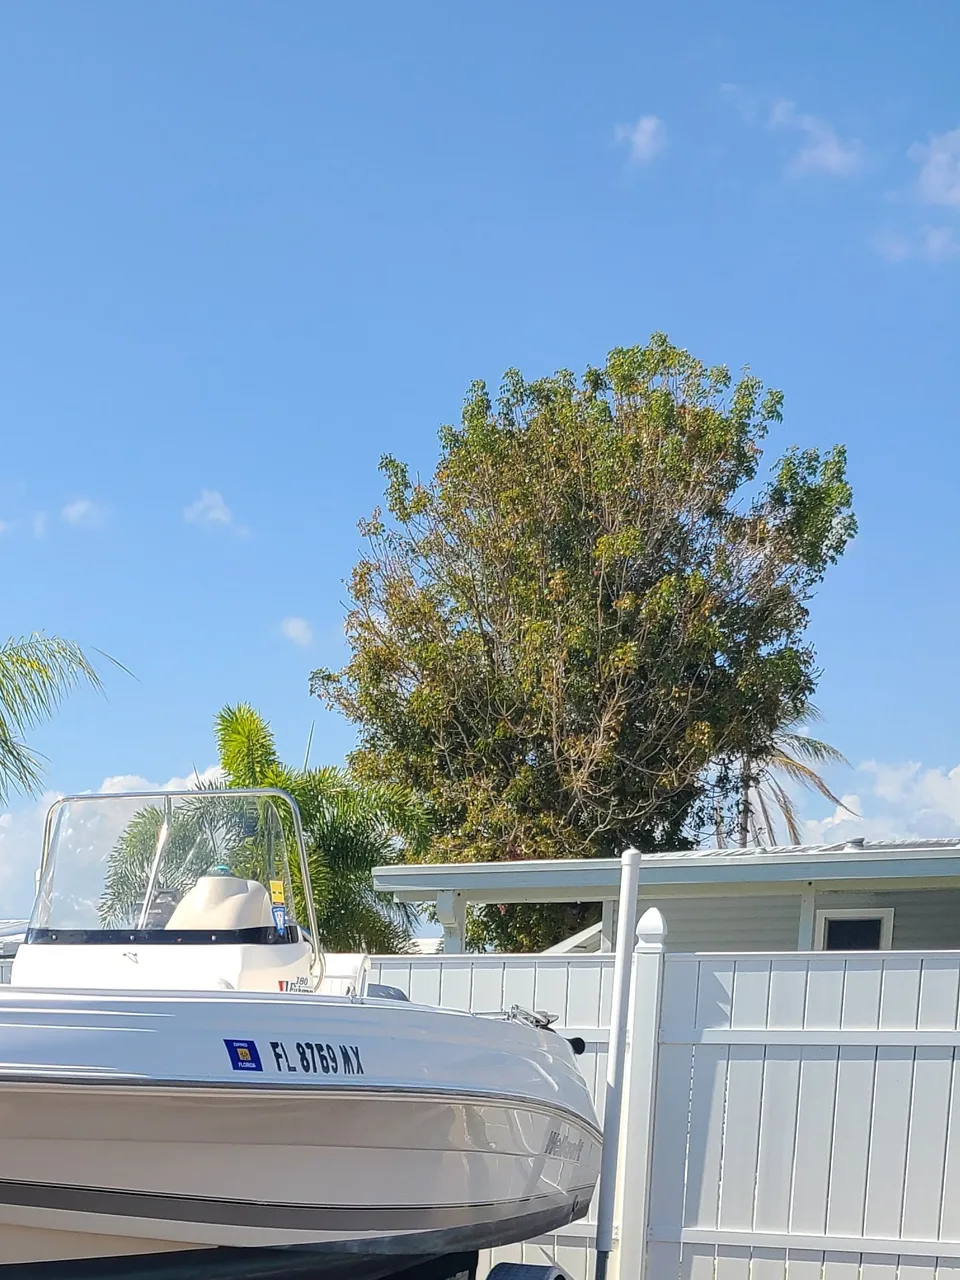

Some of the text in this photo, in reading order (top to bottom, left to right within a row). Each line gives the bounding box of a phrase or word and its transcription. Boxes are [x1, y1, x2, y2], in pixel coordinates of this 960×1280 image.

[296, 976, 308, 985] 180
[269, 1041, 297, 1072] FL
[338, 1044, 365, 1075] MX
